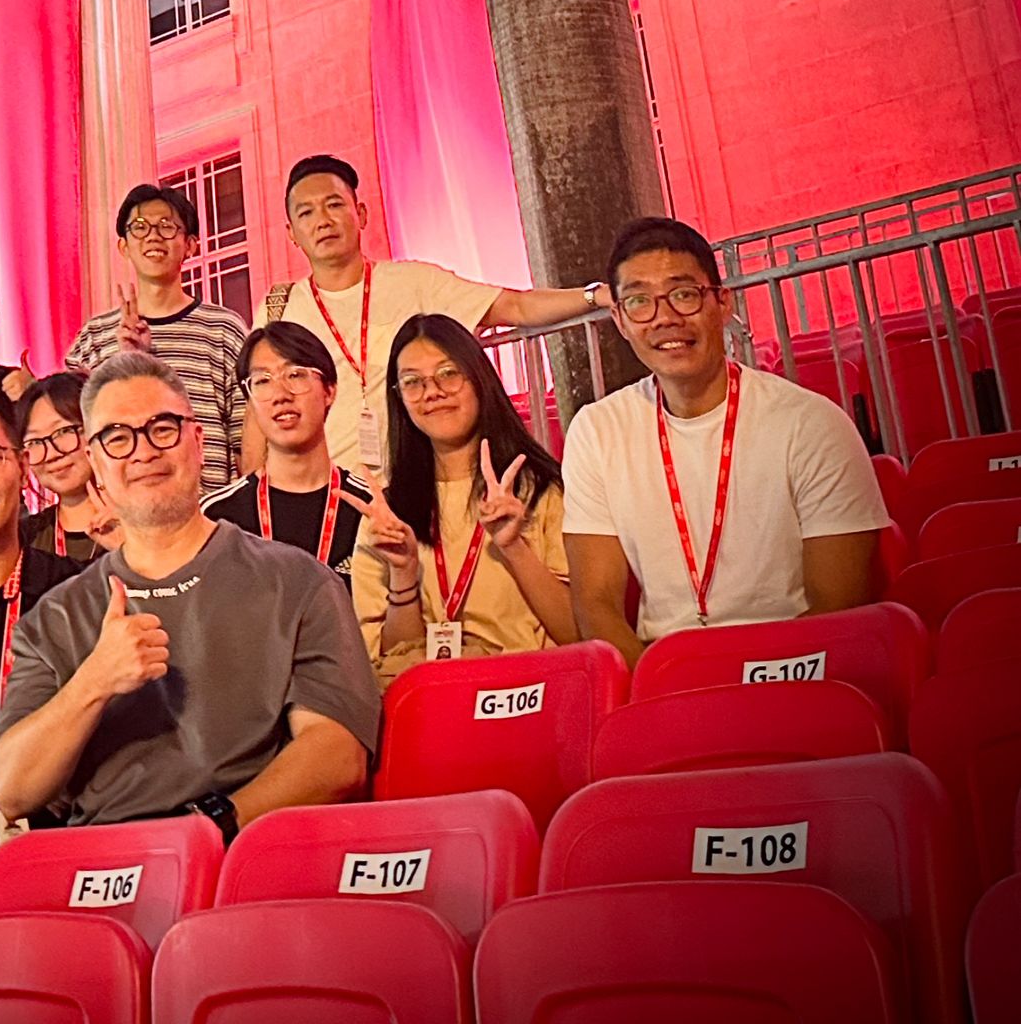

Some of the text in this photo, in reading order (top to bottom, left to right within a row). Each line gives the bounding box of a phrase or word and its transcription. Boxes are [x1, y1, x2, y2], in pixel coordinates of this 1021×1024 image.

[749, 658, 820, 684] G-107
[481, 689, 538, 714] G-106
[705, 832, 796, 866] F-108
[350, 858, 421, 887] F-107
[78, 874, 134, 901] F-106
